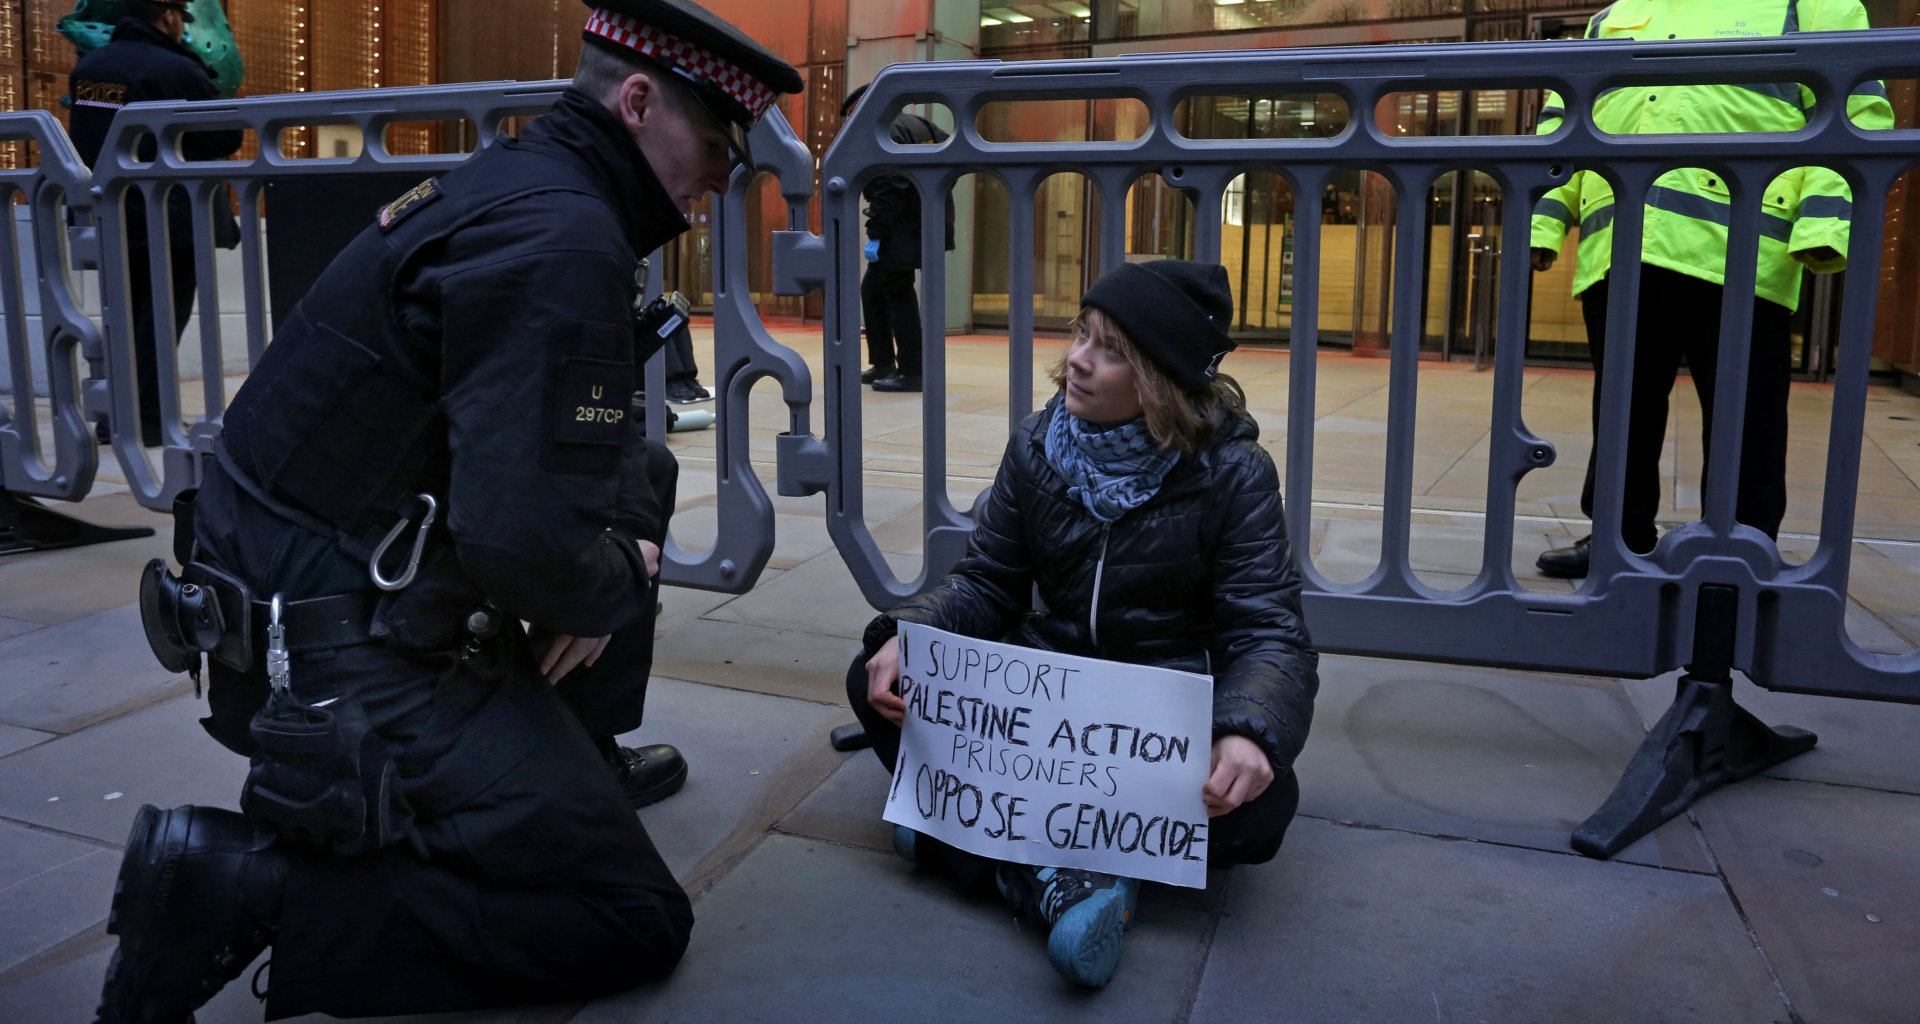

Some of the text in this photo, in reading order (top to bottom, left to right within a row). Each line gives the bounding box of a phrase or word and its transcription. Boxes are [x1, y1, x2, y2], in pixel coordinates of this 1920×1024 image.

[1714, 29, 1762, 37] Fenchurch
[77, 86, 125, 104] POLICE
[591, 385, 603, 400] U
[575, 406, 624, 424] 297CP
[926, 641, 1081, 702] SUPPORT
[900, 675, 1190, 763] PALESTINE ACTION
[952, 734, 1119, 797] PRISONERS
[916, 762, 1028, 841] OPPOSE
[1045, 803, 1208, 862] GENOCIDE
